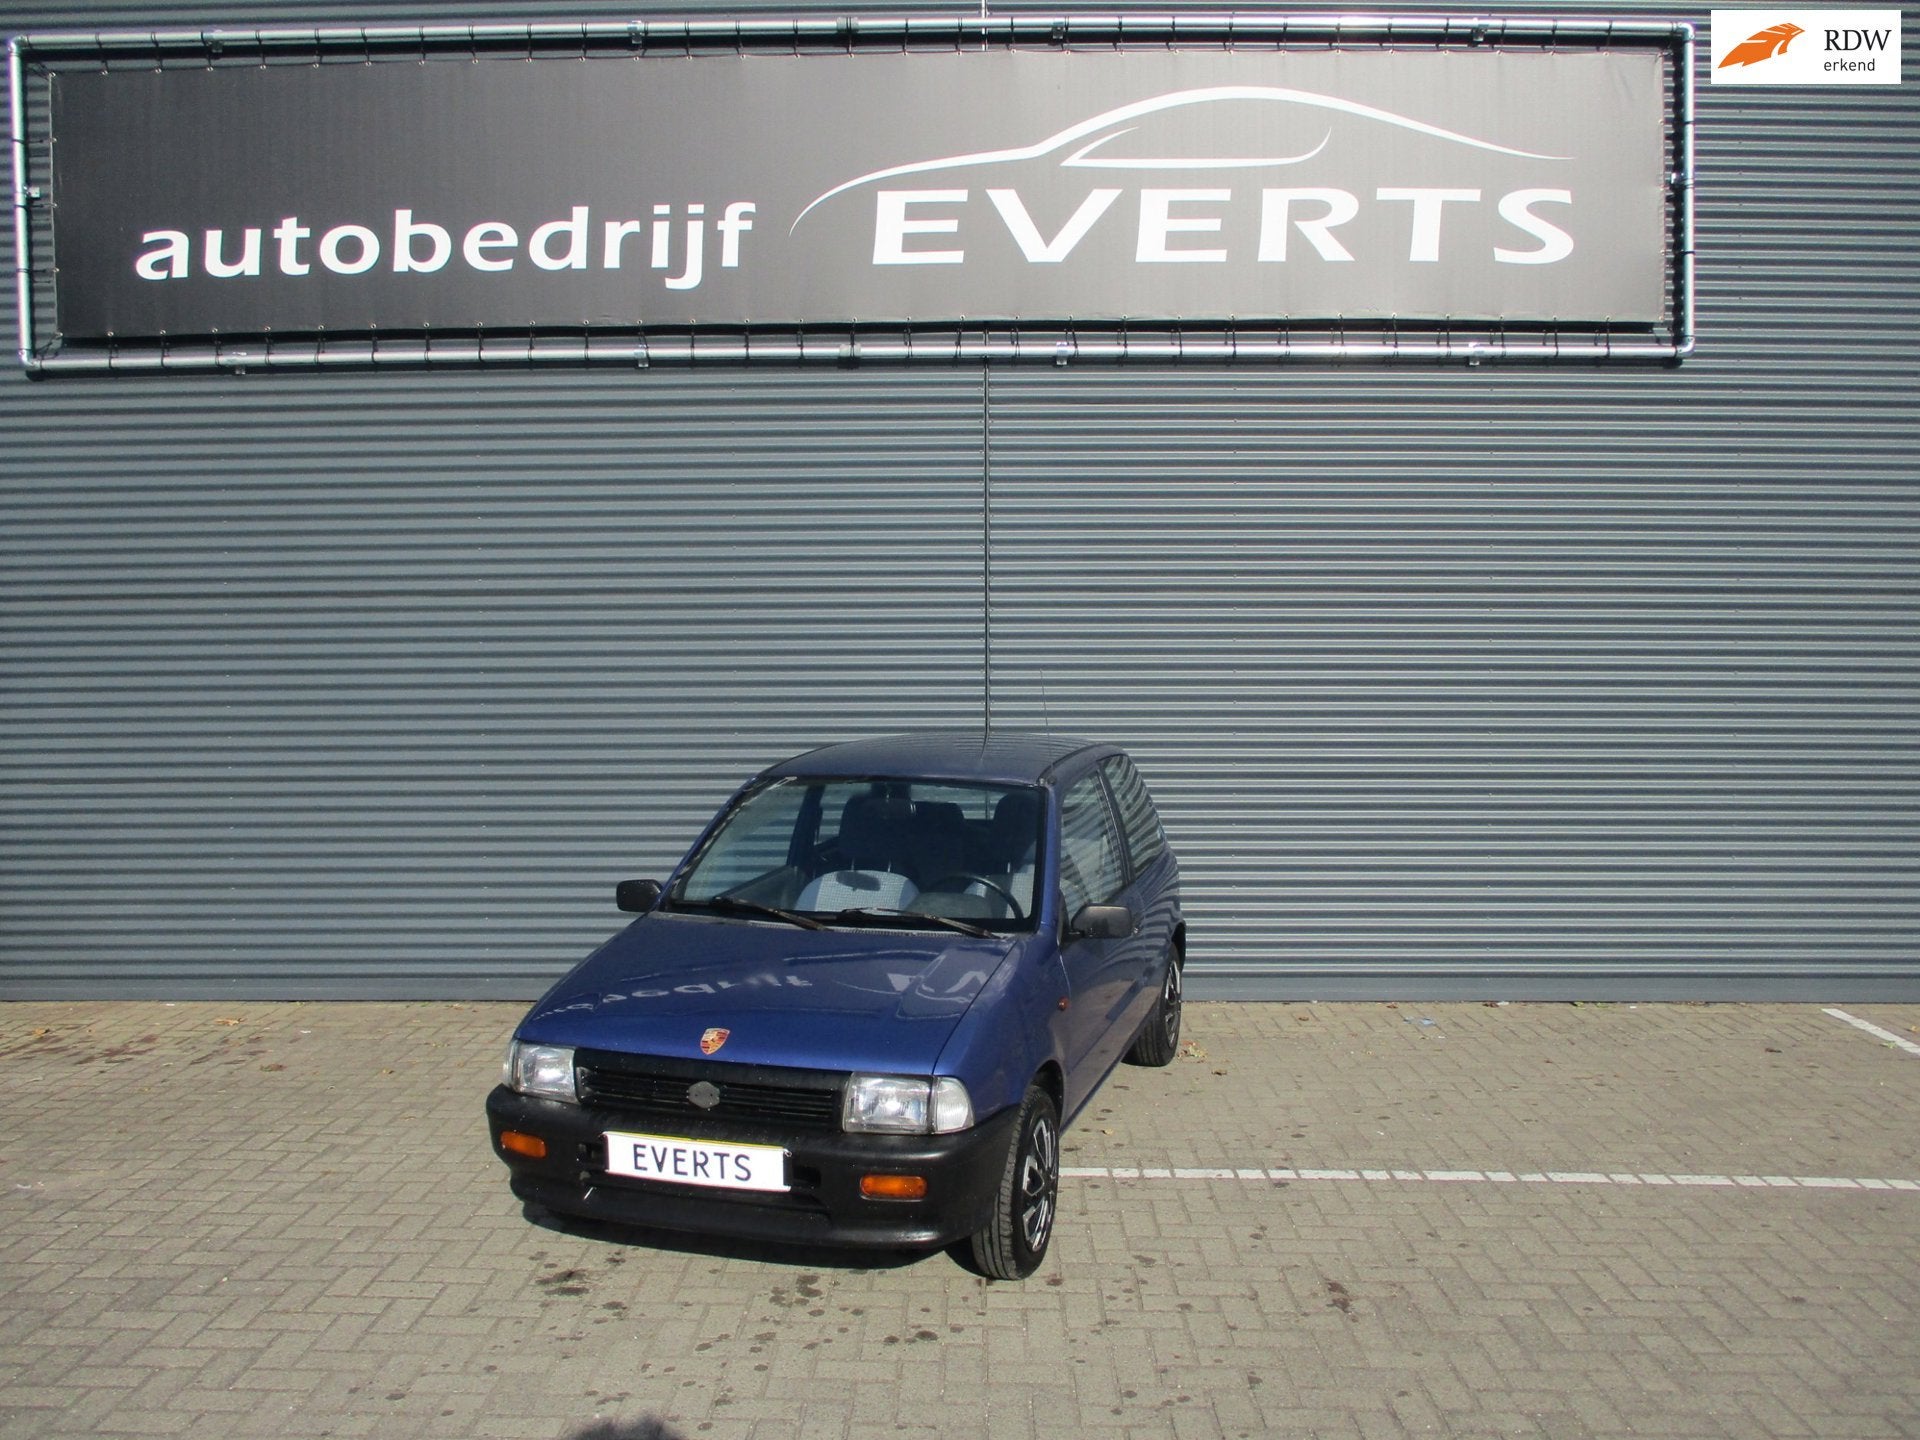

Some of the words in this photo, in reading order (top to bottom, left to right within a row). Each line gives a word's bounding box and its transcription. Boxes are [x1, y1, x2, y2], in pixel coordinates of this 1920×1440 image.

[134, 201, 757, 290] autobedrijf
[872, 187, 1575, 266] EVERTS
[632, 1143, 752, 1182] EVERTS
